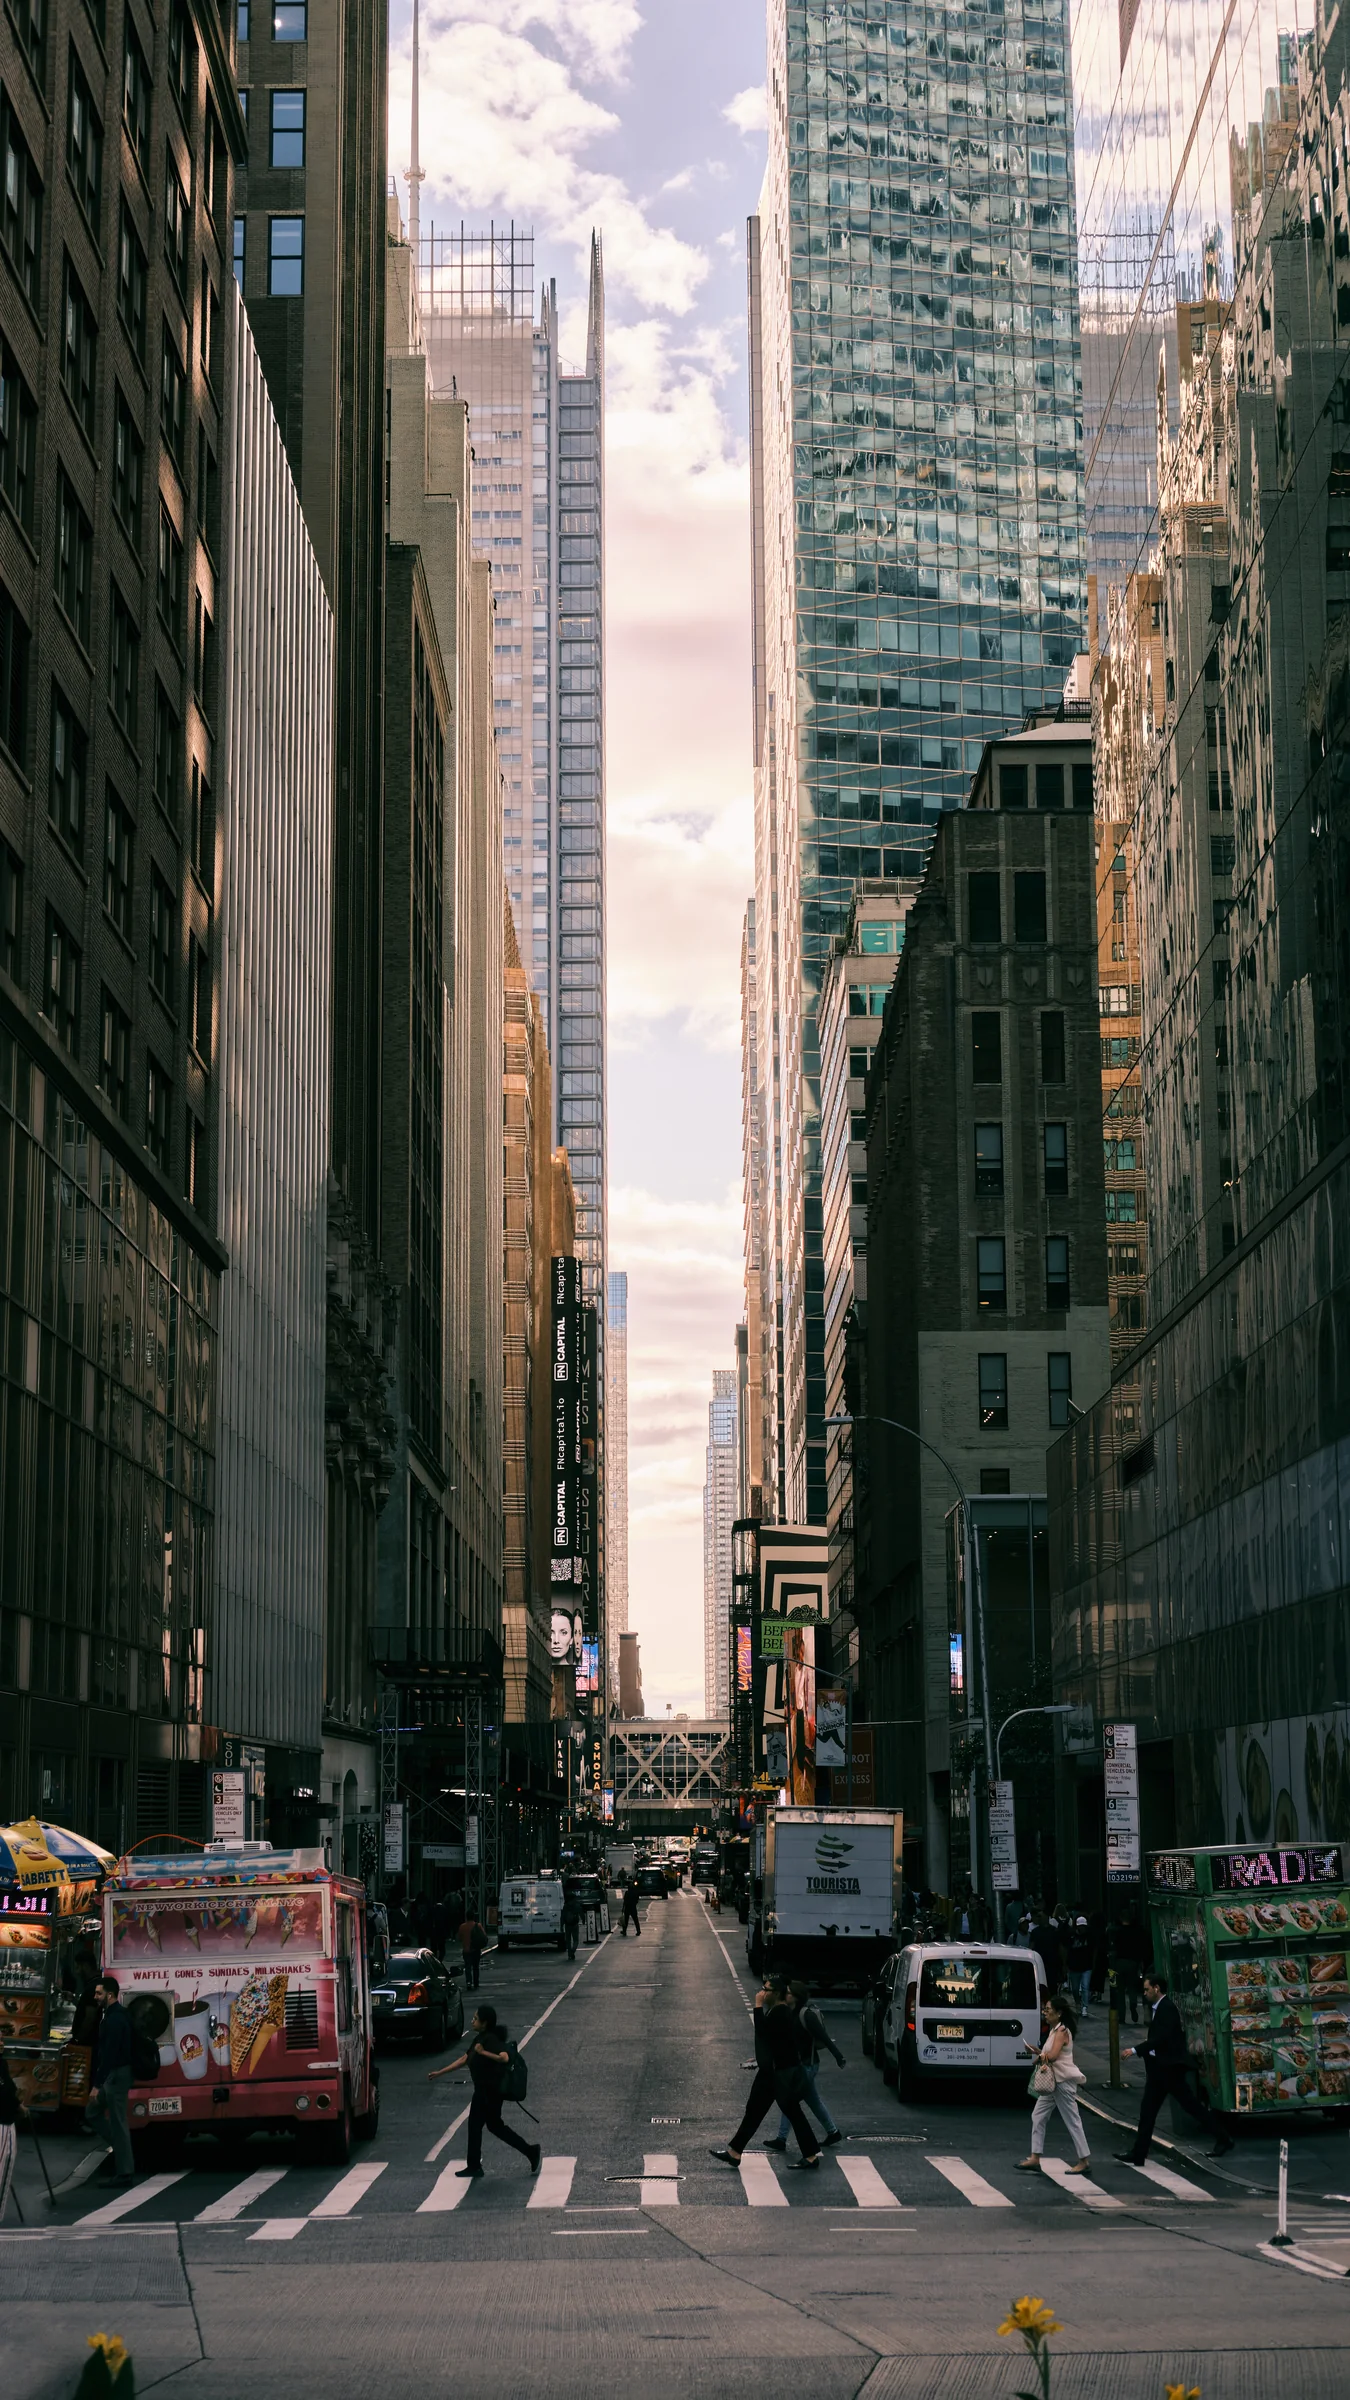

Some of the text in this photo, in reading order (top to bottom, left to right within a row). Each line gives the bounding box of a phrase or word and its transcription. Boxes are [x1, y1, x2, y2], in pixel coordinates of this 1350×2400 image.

[556, 1317, 566, 1378] FN CAPITAL
[582, 1313, 590, 1424] TIMES
[557, 1397, 566, 1470] FNcapital.io
[556, 1480, 566, 1543] FN CAPITAL
[582, 1488, 590, 1625] SQUARE
[1107, 1749, 1113, 1759] 3
[216, 1796, 222, 1804] 3
[1108, 1800, 1115, 1809] 6
[22, 1868, 66, 1886] SABRETT
[806, 1876, 860, 1890] TOURISTA
[133, 1964, 311, 1980] WAFFLE CONES SUNDAES MILKSHAKES
